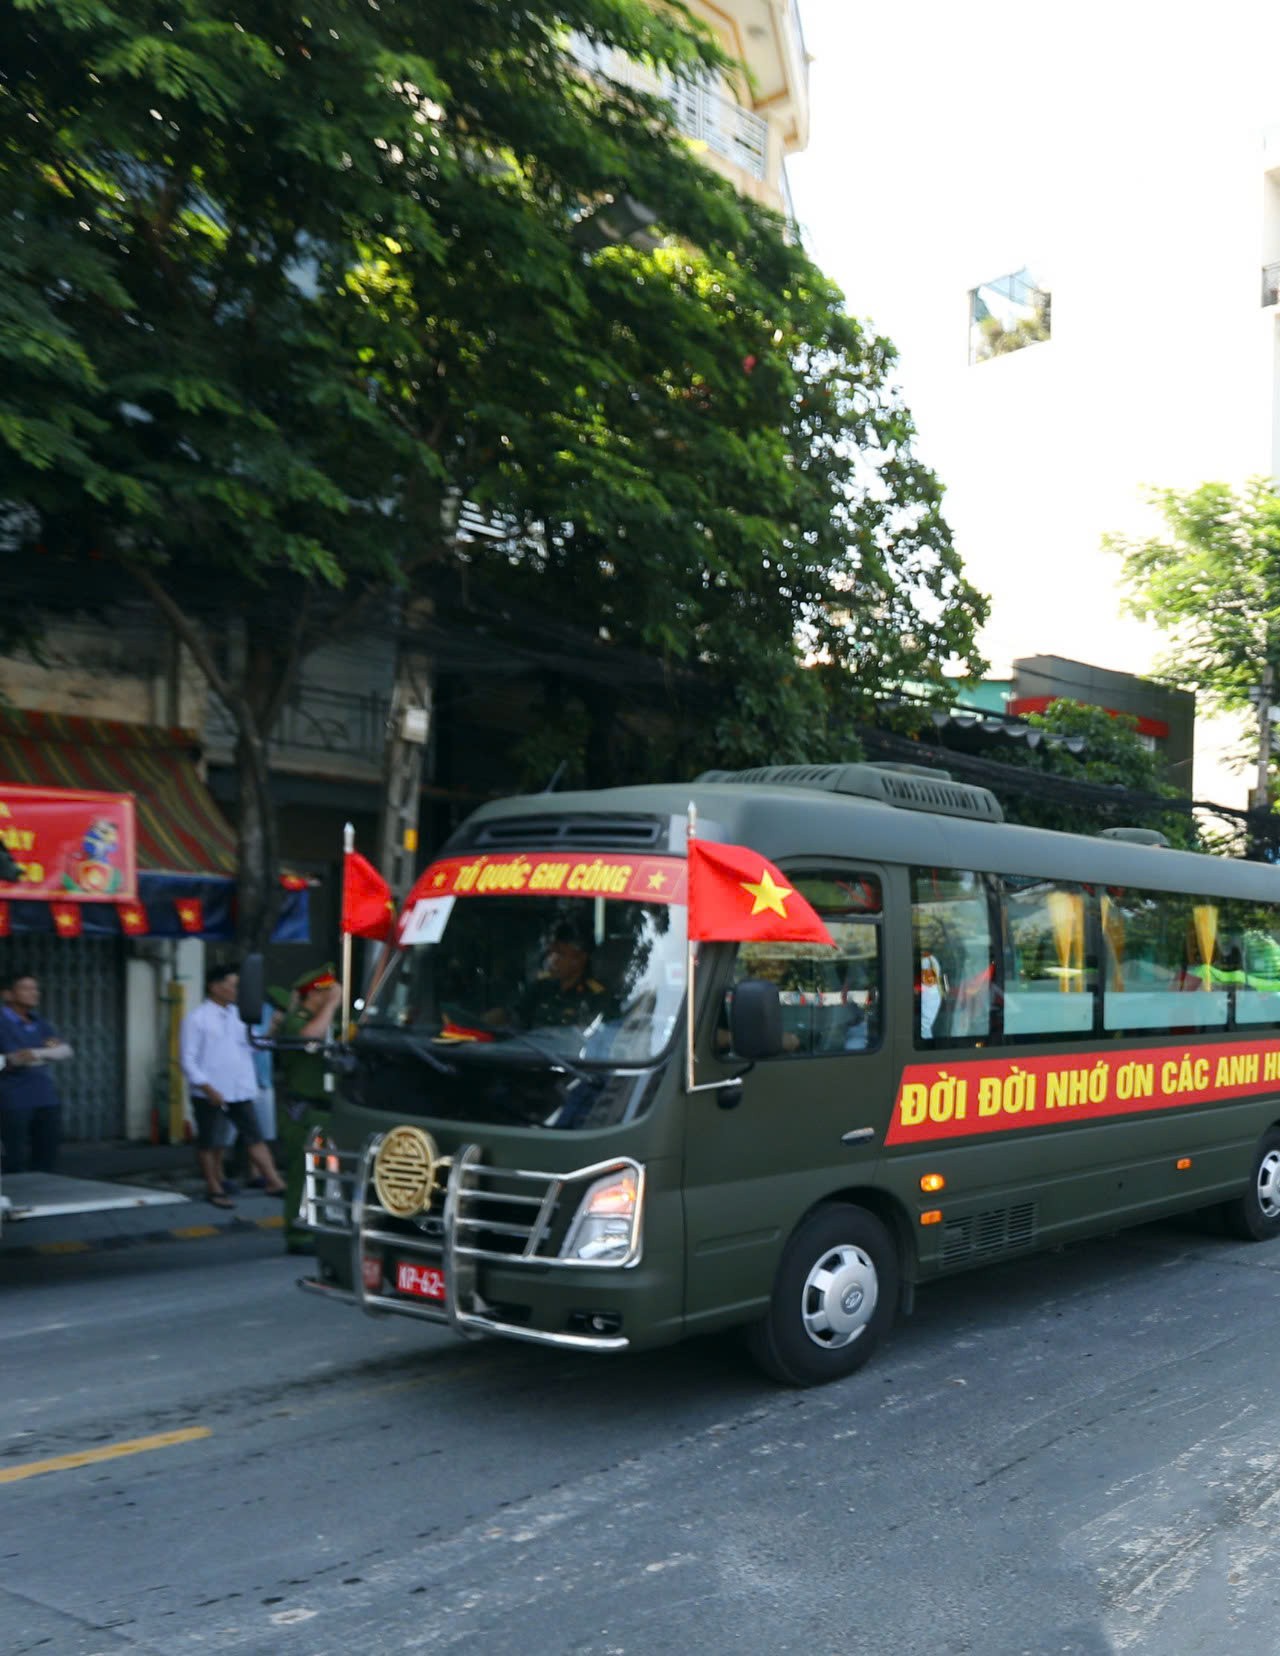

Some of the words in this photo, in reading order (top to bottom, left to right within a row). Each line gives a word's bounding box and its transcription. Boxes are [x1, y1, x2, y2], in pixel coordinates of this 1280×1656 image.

[454, 856, 486, 891] TỔ
[478, 857, 531, 892] QUỐC
[531, 863, 569, 889] GHI
[568, 859, 632, 893] CÔNG
[900, 1071, 967, 1126] ĐỜI
[978, 1065, 1036, 1117] ĐỜI
[1046, 1060, 1109, 1109] NHỚ
[1116, 1062, 1154, 1100] ƠN
[1162, 1052, 1209, 1095] CÁC
[1215, 1053, 1259, 1088] ANH
